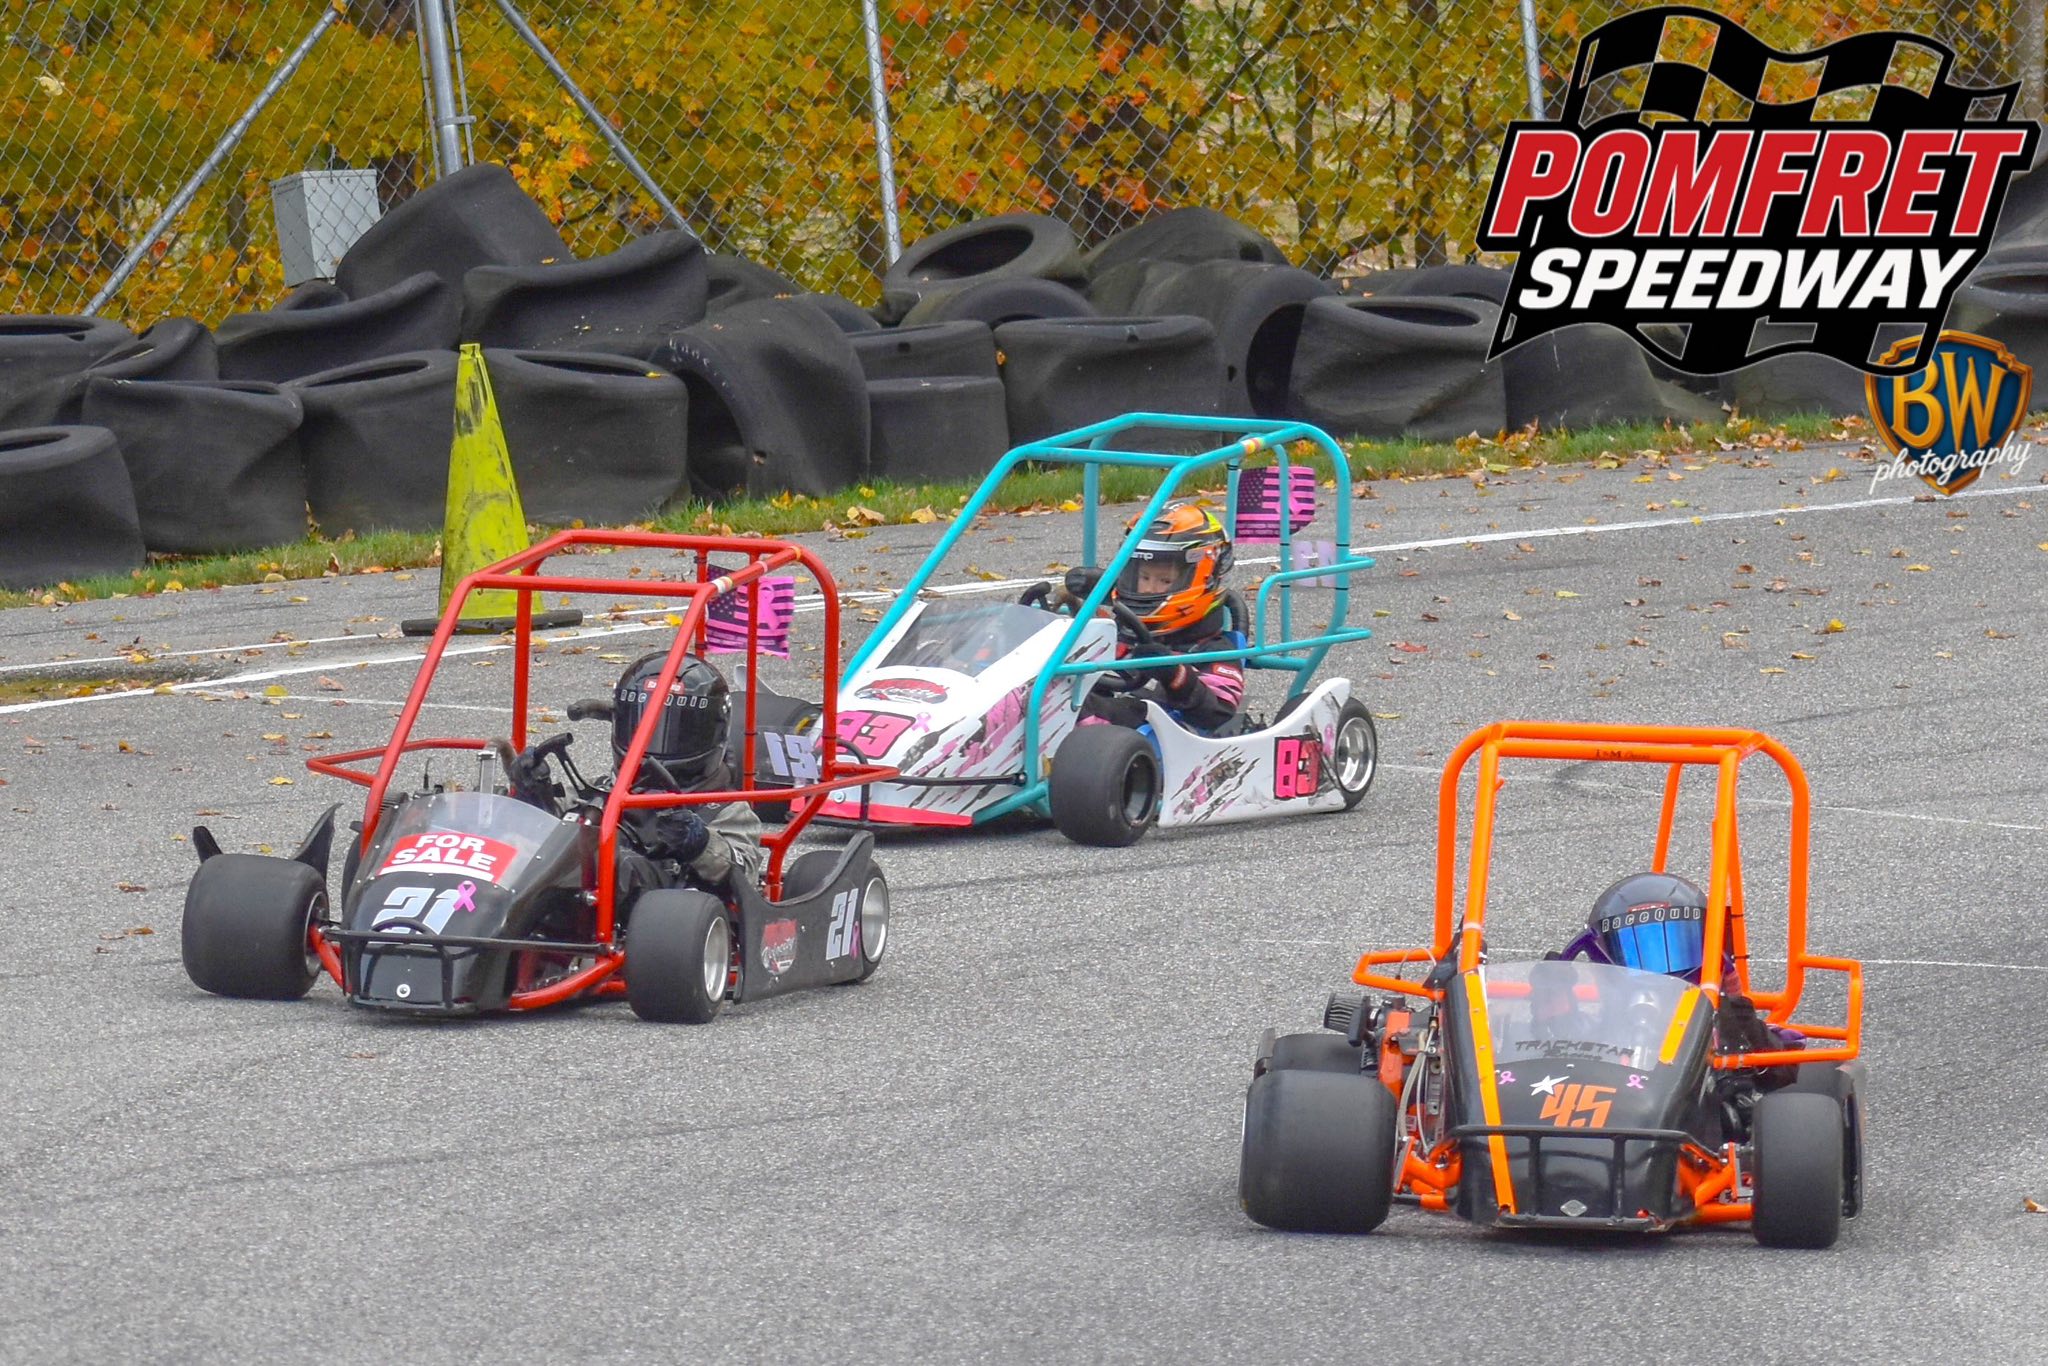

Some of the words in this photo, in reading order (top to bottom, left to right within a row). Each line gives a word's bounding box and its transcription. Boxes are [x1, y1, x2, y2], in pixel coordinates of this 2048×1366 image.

[391, 847, 497, 871] SALE
[416, 834, 486, 853] FOR
[370, 886, 464, 936] 21
[825, 887, 859, 961] 21
[1540, 1083, 1618, 1129] 45
